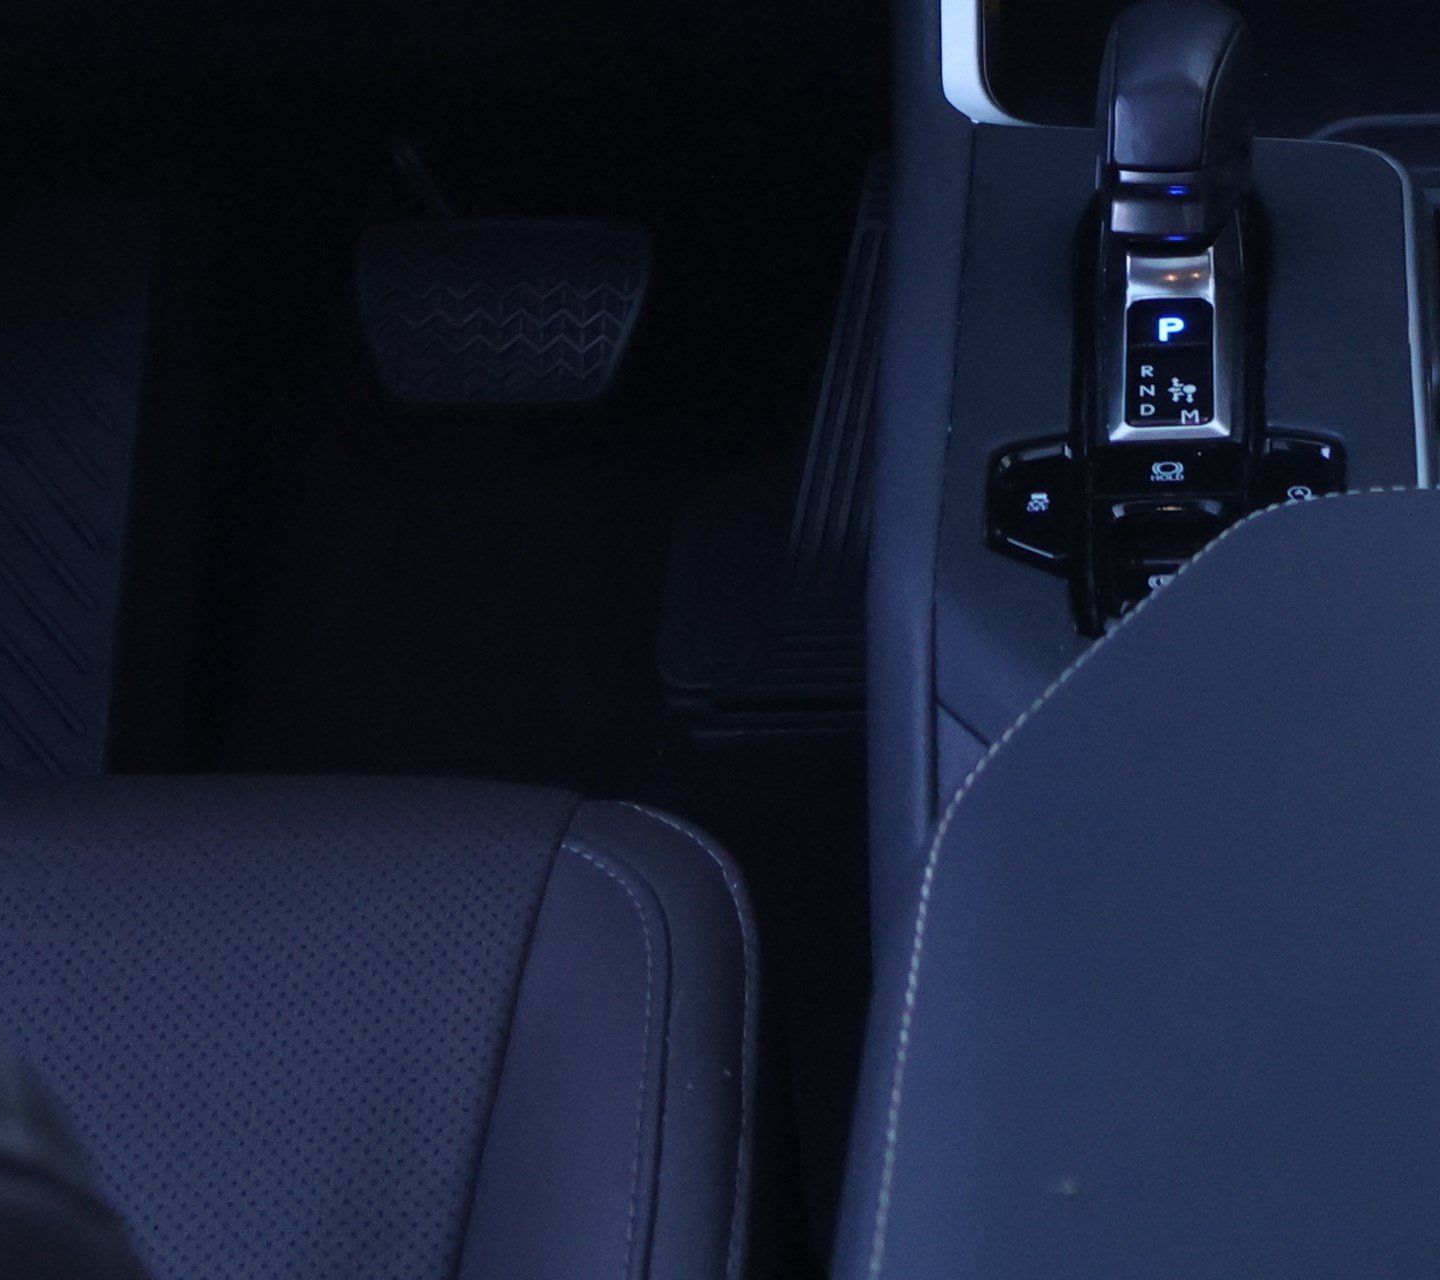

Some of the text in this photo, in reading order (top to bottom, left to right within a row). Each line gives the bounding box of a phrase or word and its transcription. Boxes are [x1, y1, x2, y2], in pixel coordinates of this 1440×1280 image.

[1158, 316, 1184, 342] P
[1141, 365, 1154, 377] R
[1139, 384, 1155, 397] N
[1140, 403, 1155, 416] D
[1181, 409, 1199, 424] M
